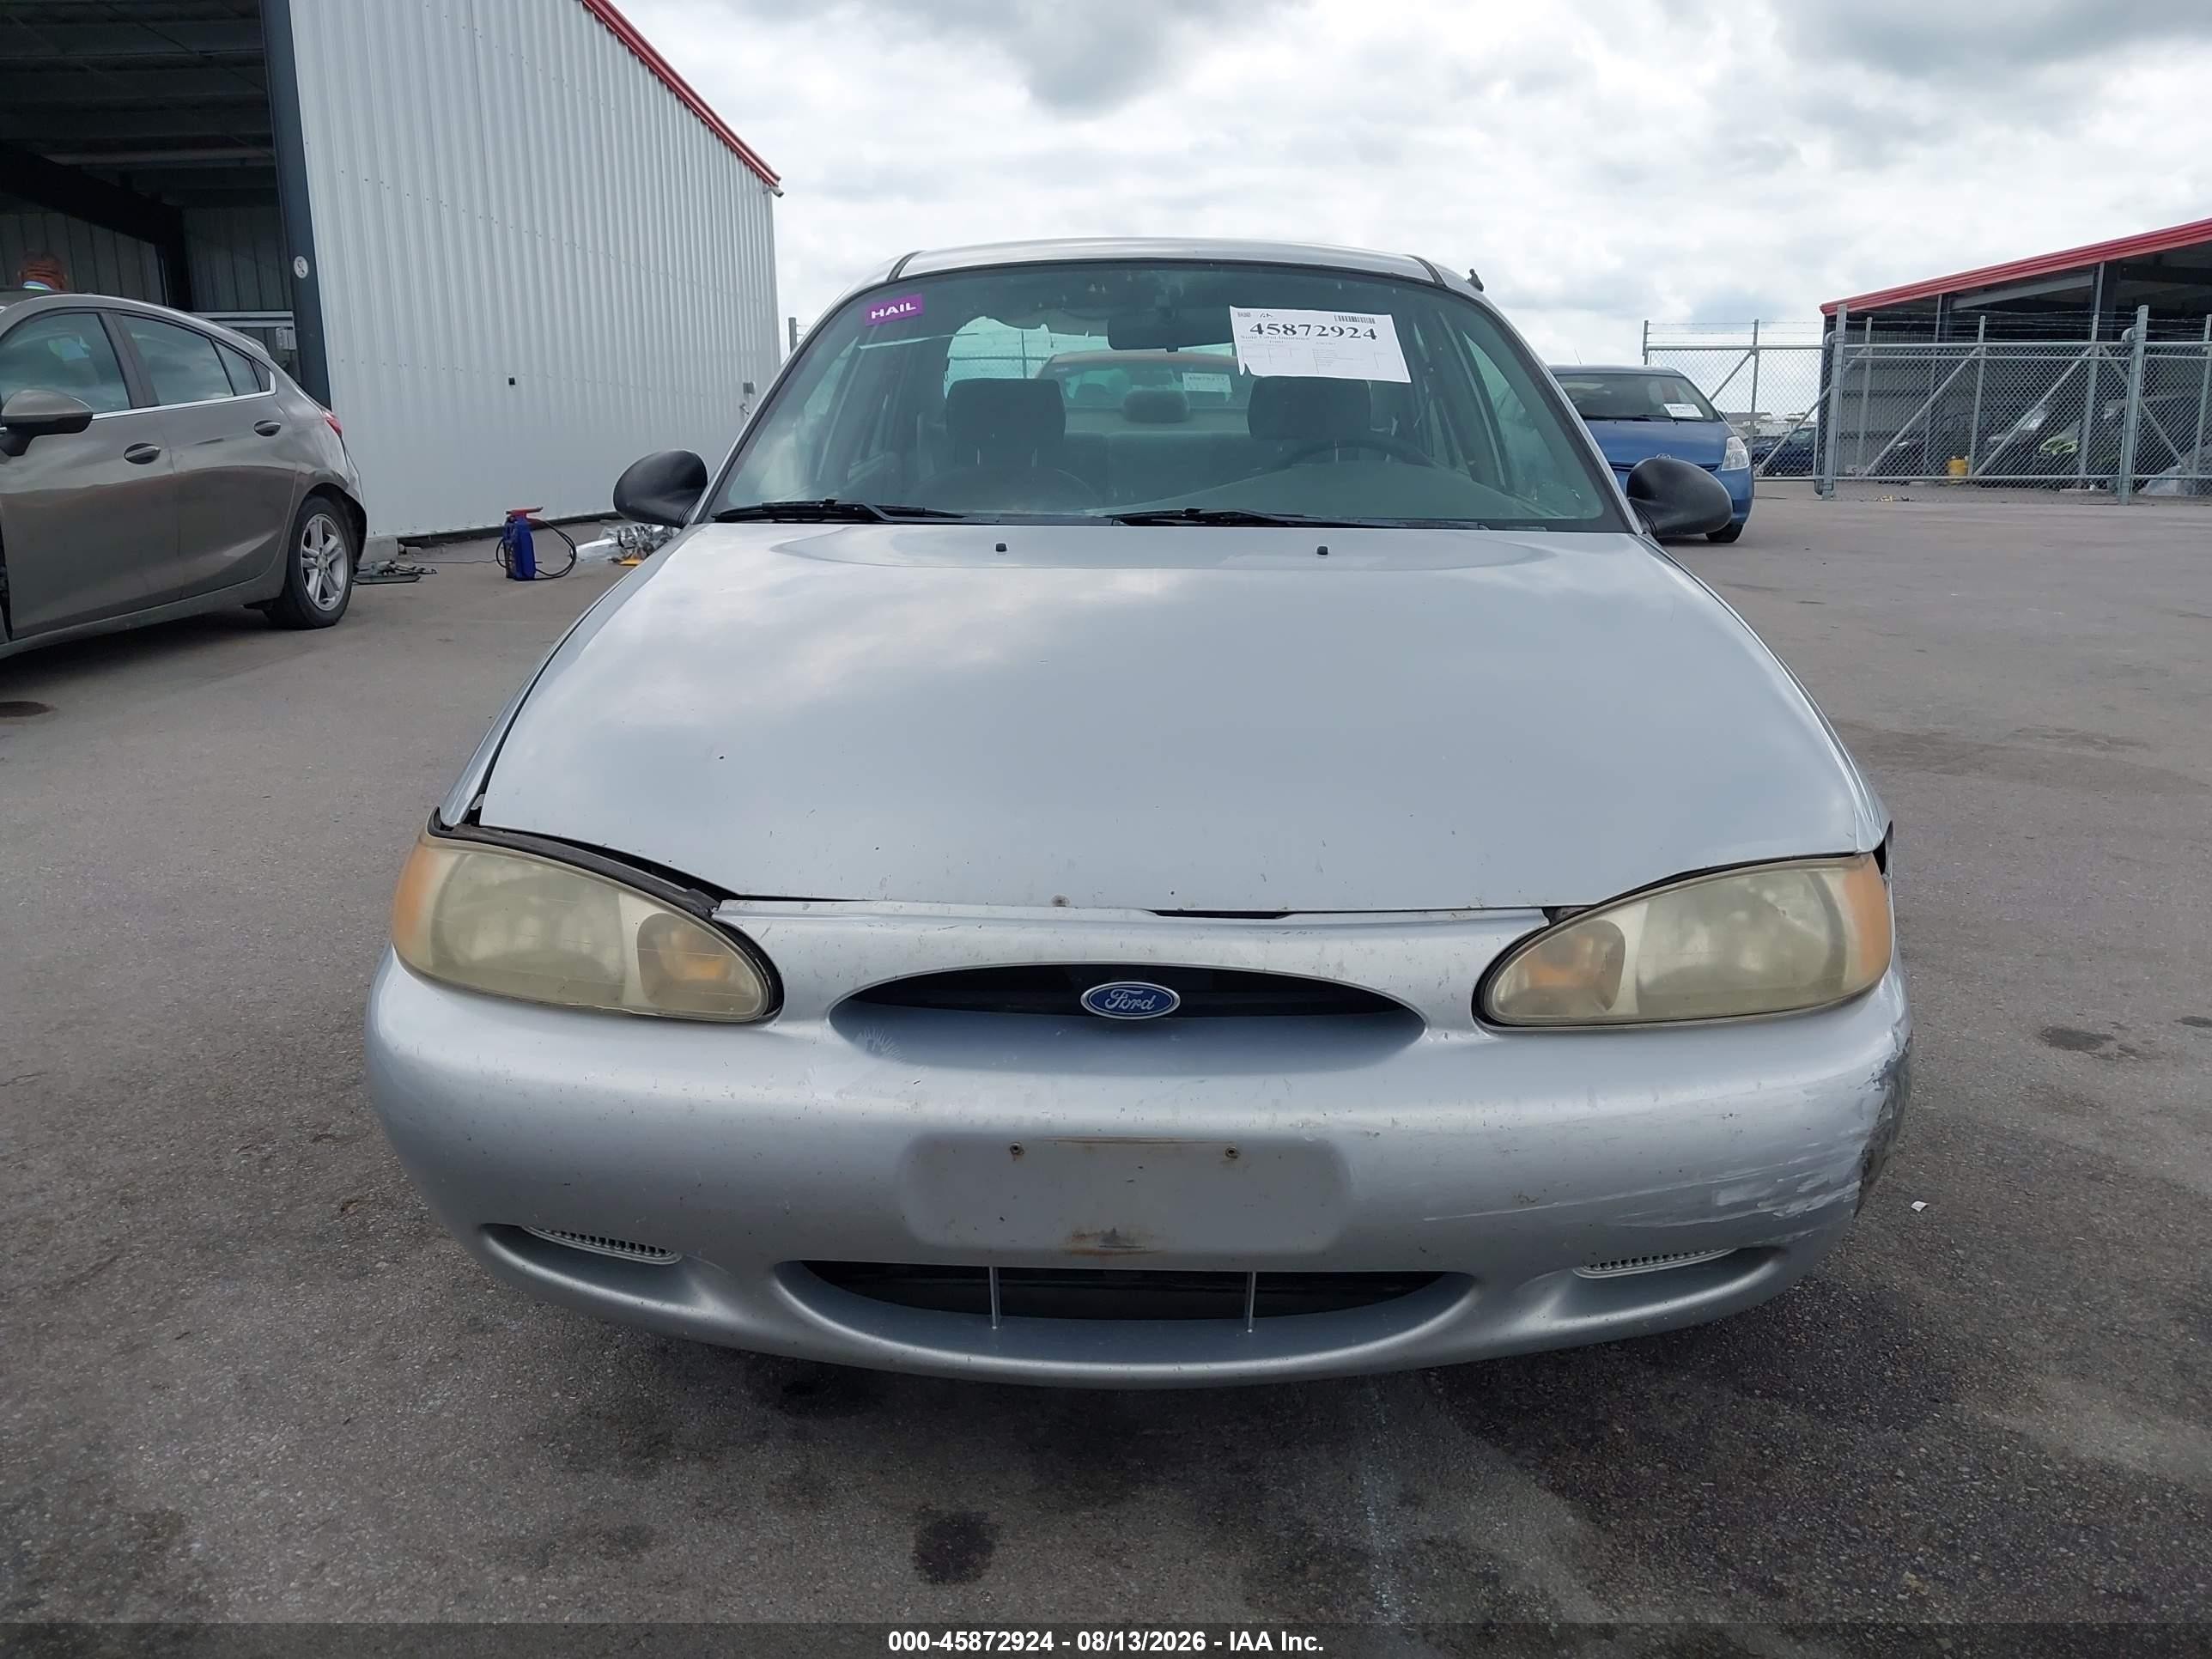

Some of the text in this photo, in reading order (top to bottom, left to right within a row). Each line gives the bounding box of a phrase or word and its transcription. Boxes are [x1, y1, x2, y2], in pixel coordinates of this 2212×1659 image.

[871, 302, 917, 319] HAIL
[1249, 322, 1378, 341] 45872924
[1104, 988, 1157, 1010] Ford
